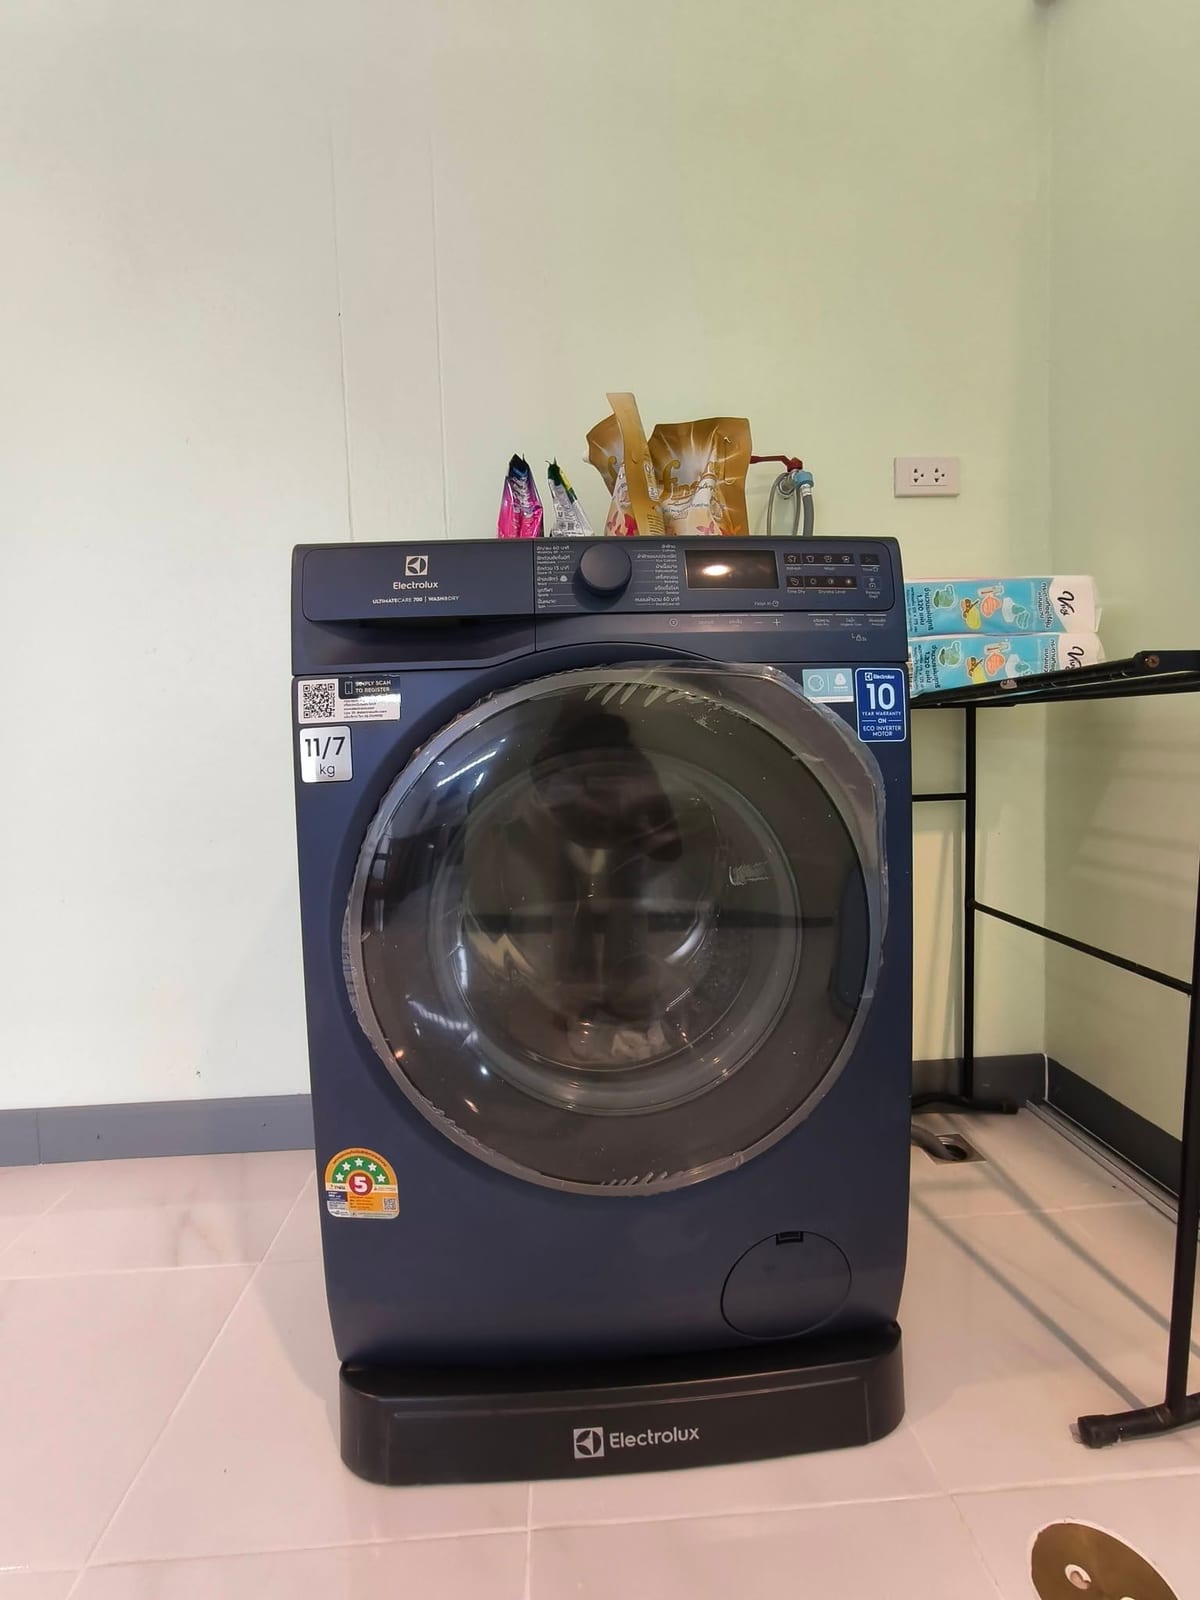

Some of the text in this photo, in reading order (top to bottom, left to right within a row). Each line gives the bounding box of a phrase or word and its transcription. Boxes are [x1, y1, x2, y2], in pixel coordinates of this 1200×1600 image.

[393, 581, 439, 590] Electrolux
[866, 683, 895, 710] 10
[305, 736, 345, 760] 11/7
[320, 764, 335, 777] kg
[354, 1176, 368, 1193] 5
[609, 1426, 700, 1448] Electrolux
